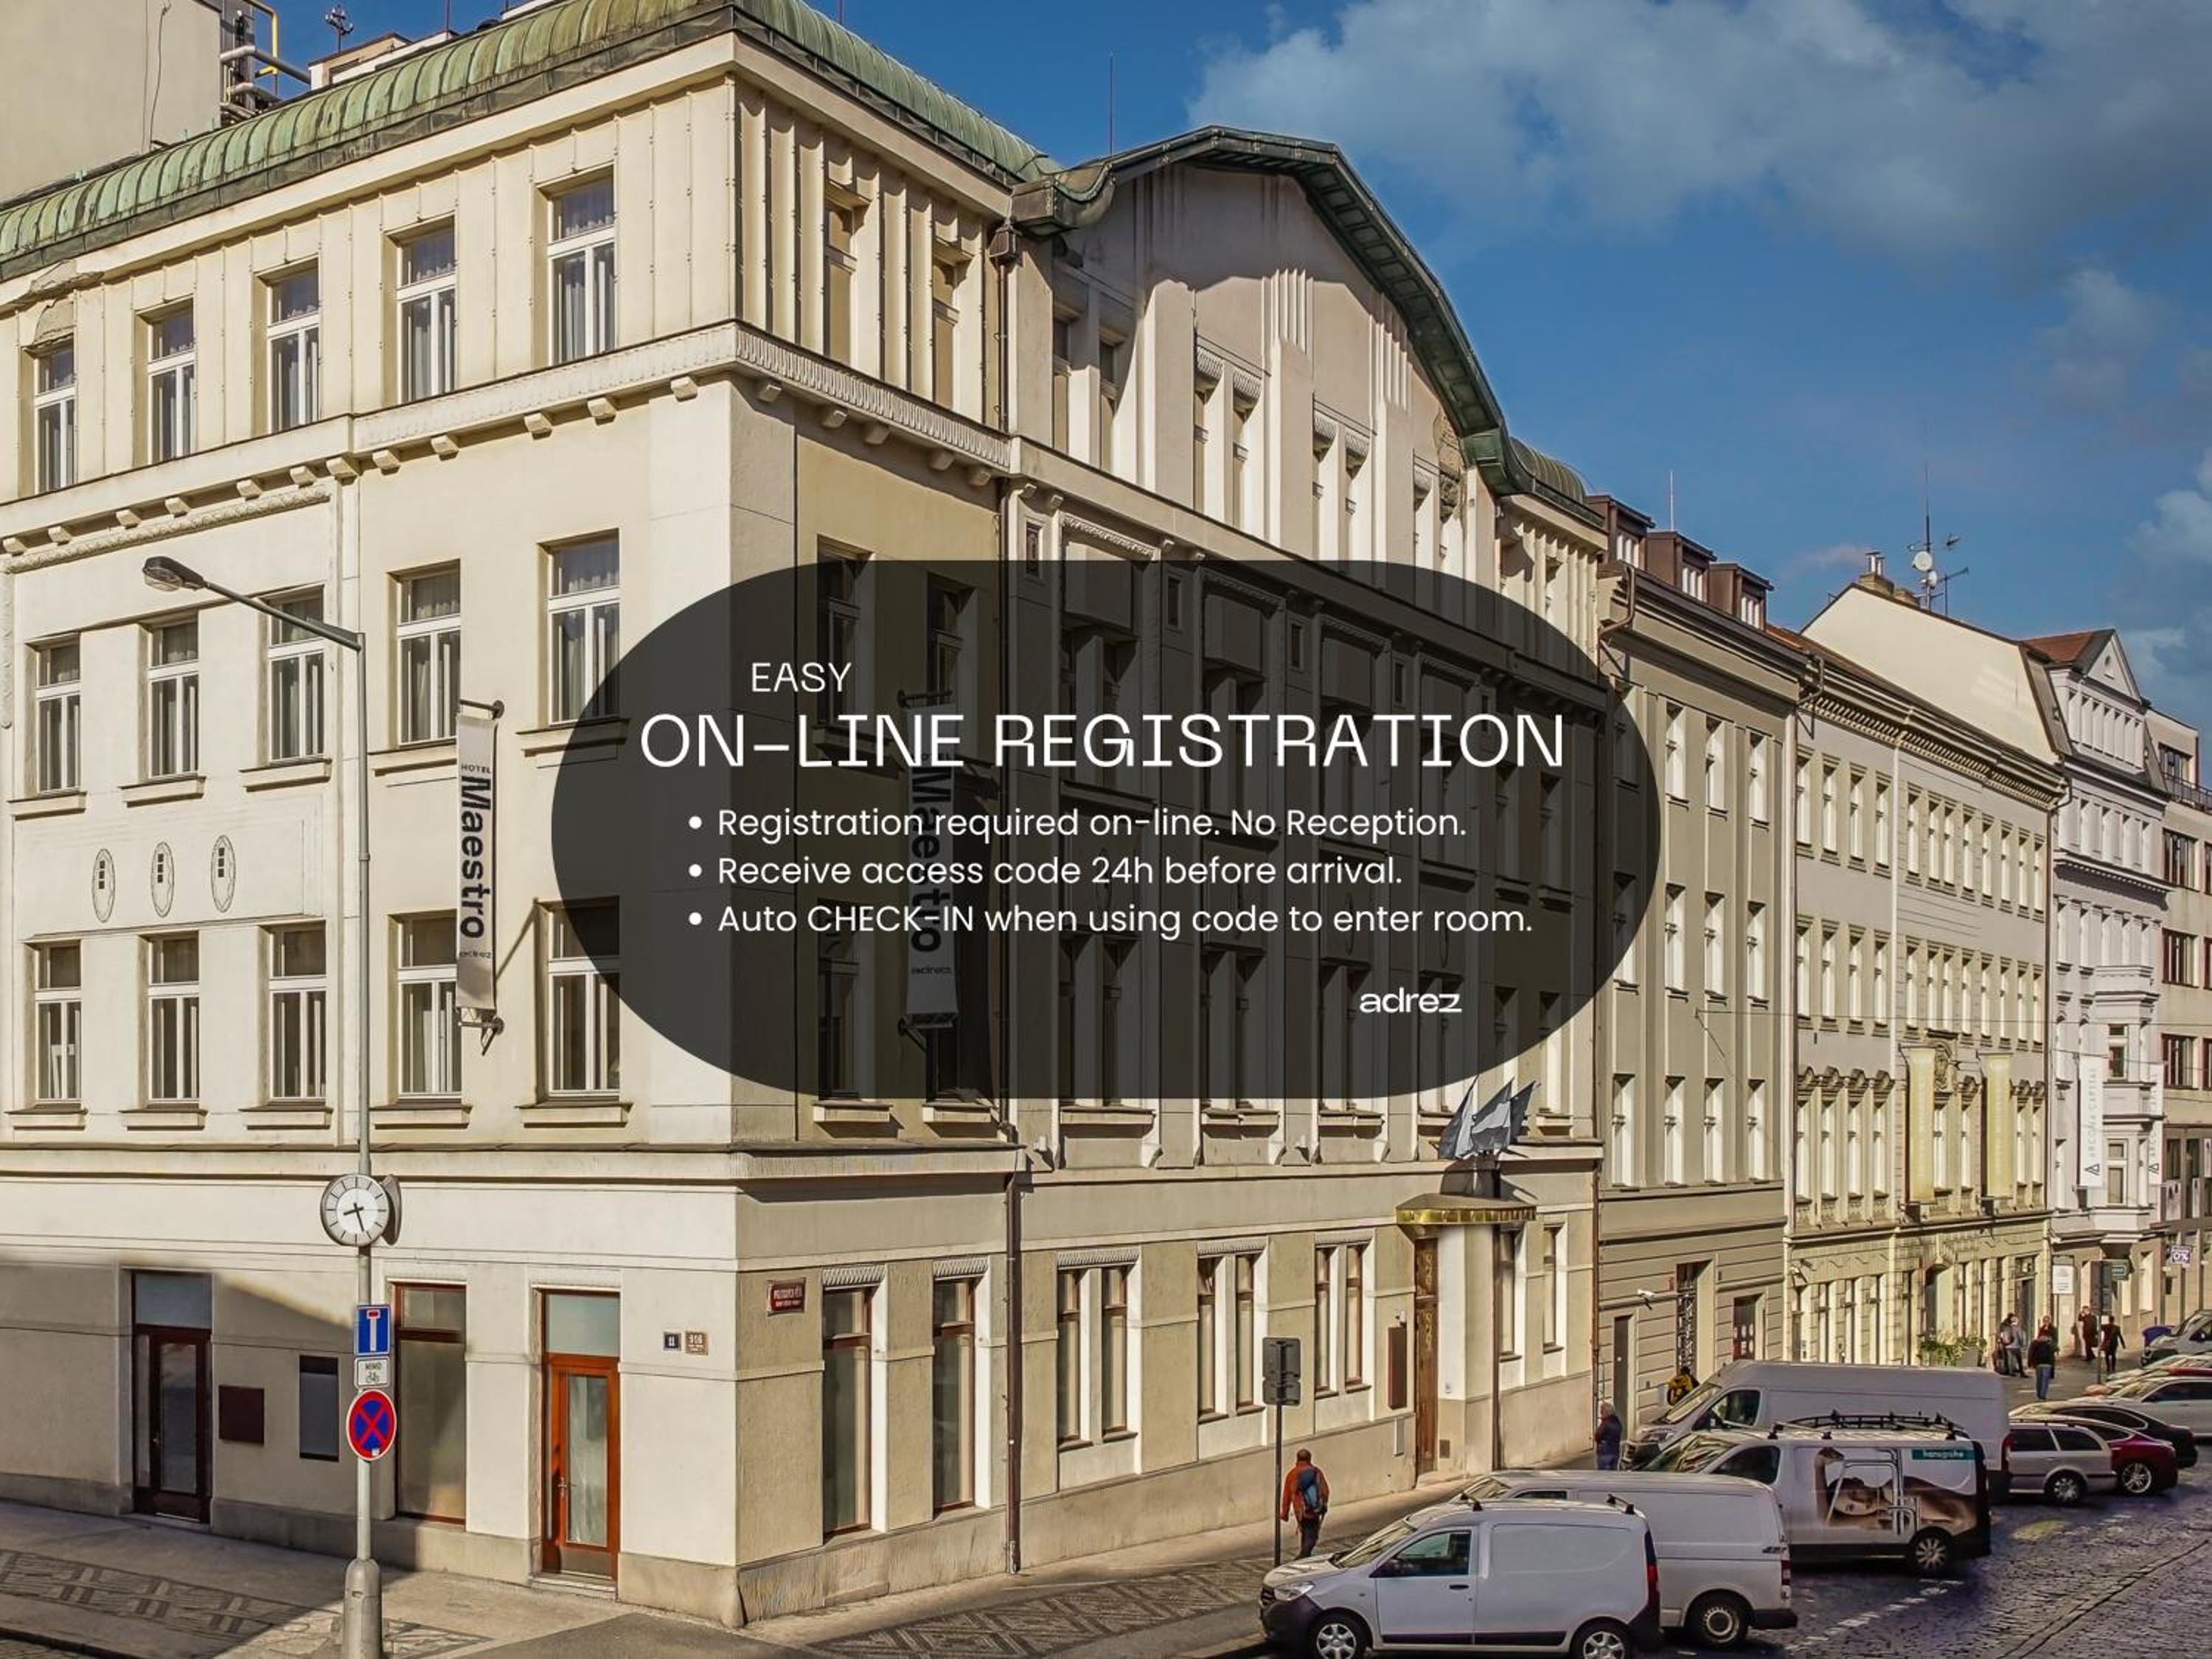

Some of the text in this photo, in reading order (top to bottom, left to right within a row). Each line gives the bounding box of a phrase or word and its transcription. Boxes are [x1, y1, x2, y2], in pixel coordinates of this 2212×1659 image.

[461, 764, 491, 773] HOTEL
[460, 775, 491, 939] Maestro
[911, 767, 952, 952] Maetro
